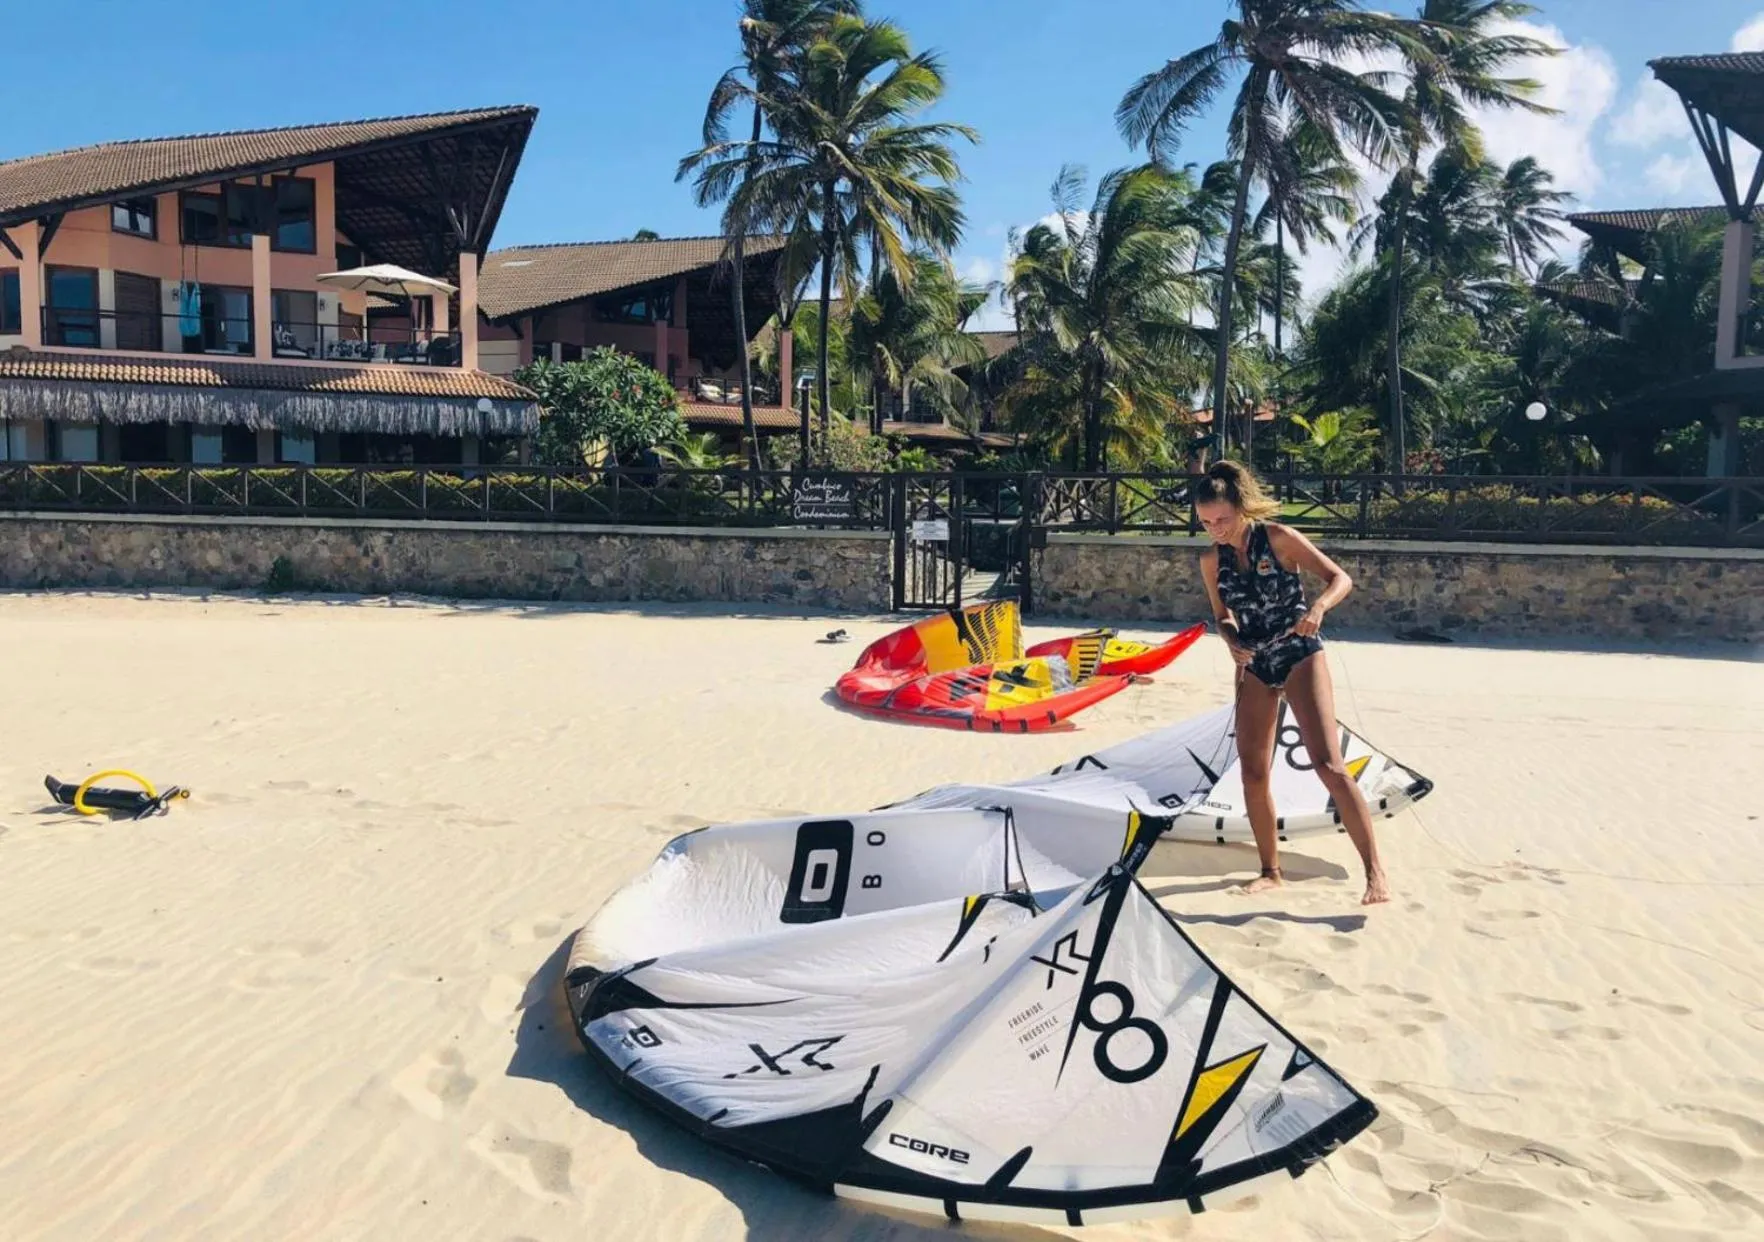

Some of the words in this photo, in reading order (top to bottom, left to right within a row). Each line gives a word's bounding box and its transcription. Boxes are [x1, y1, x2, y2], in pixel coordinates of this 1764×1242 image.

[794, 488, 823, 503] Dream
[825, 490, 850, 503] Beach
[1007, 1001, 1044, 1029] FREERIDE
[1017, 1016, 1060, 1045] FREESTYLE
[1078, 980, 1168, 1083] 8
[1028, 1044, 1051, 1062] WAVE
[888, 1132, 971, 1165] CORE
